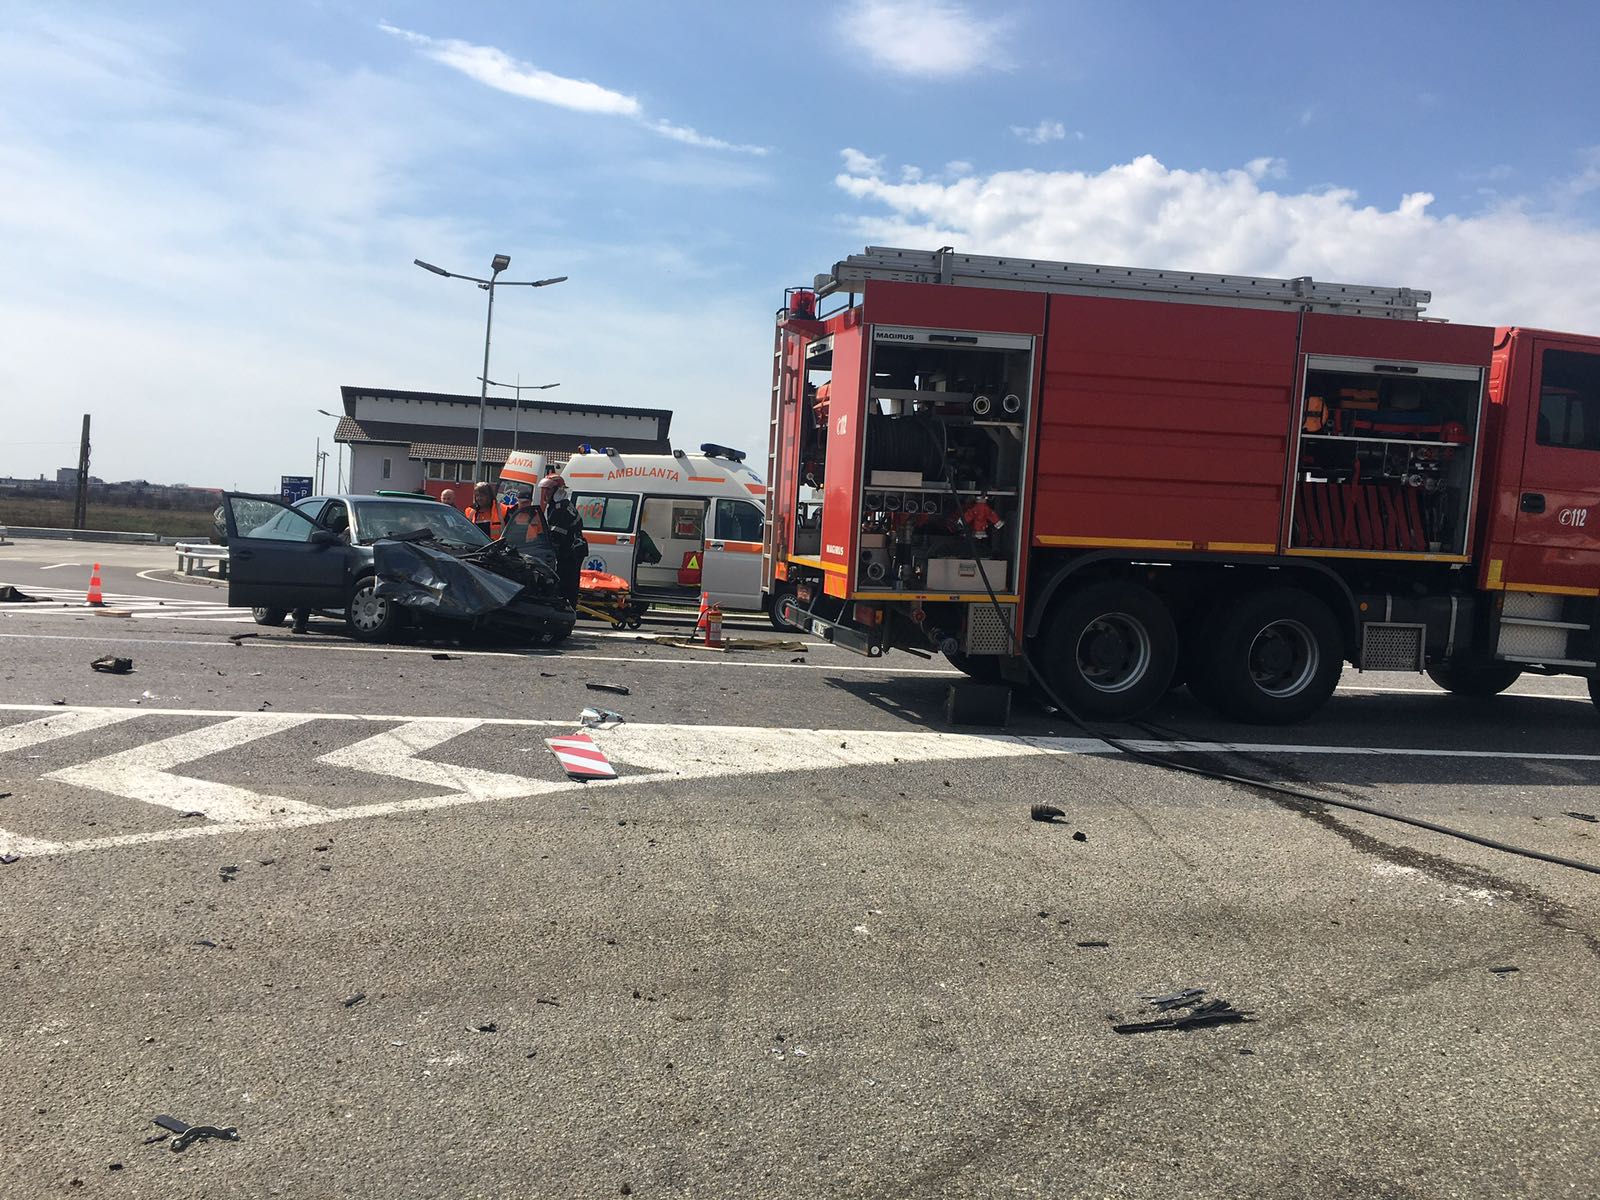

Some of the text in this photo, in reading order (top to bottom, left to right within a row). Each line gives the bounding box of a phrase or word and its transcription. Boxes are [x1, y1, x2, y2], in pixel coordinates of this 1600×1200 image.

[876, 332, 914, 340] MAGIRUS
[607, 466, 679, 482] AMBULANTA
[1570, 508, 1587, 527] 112
